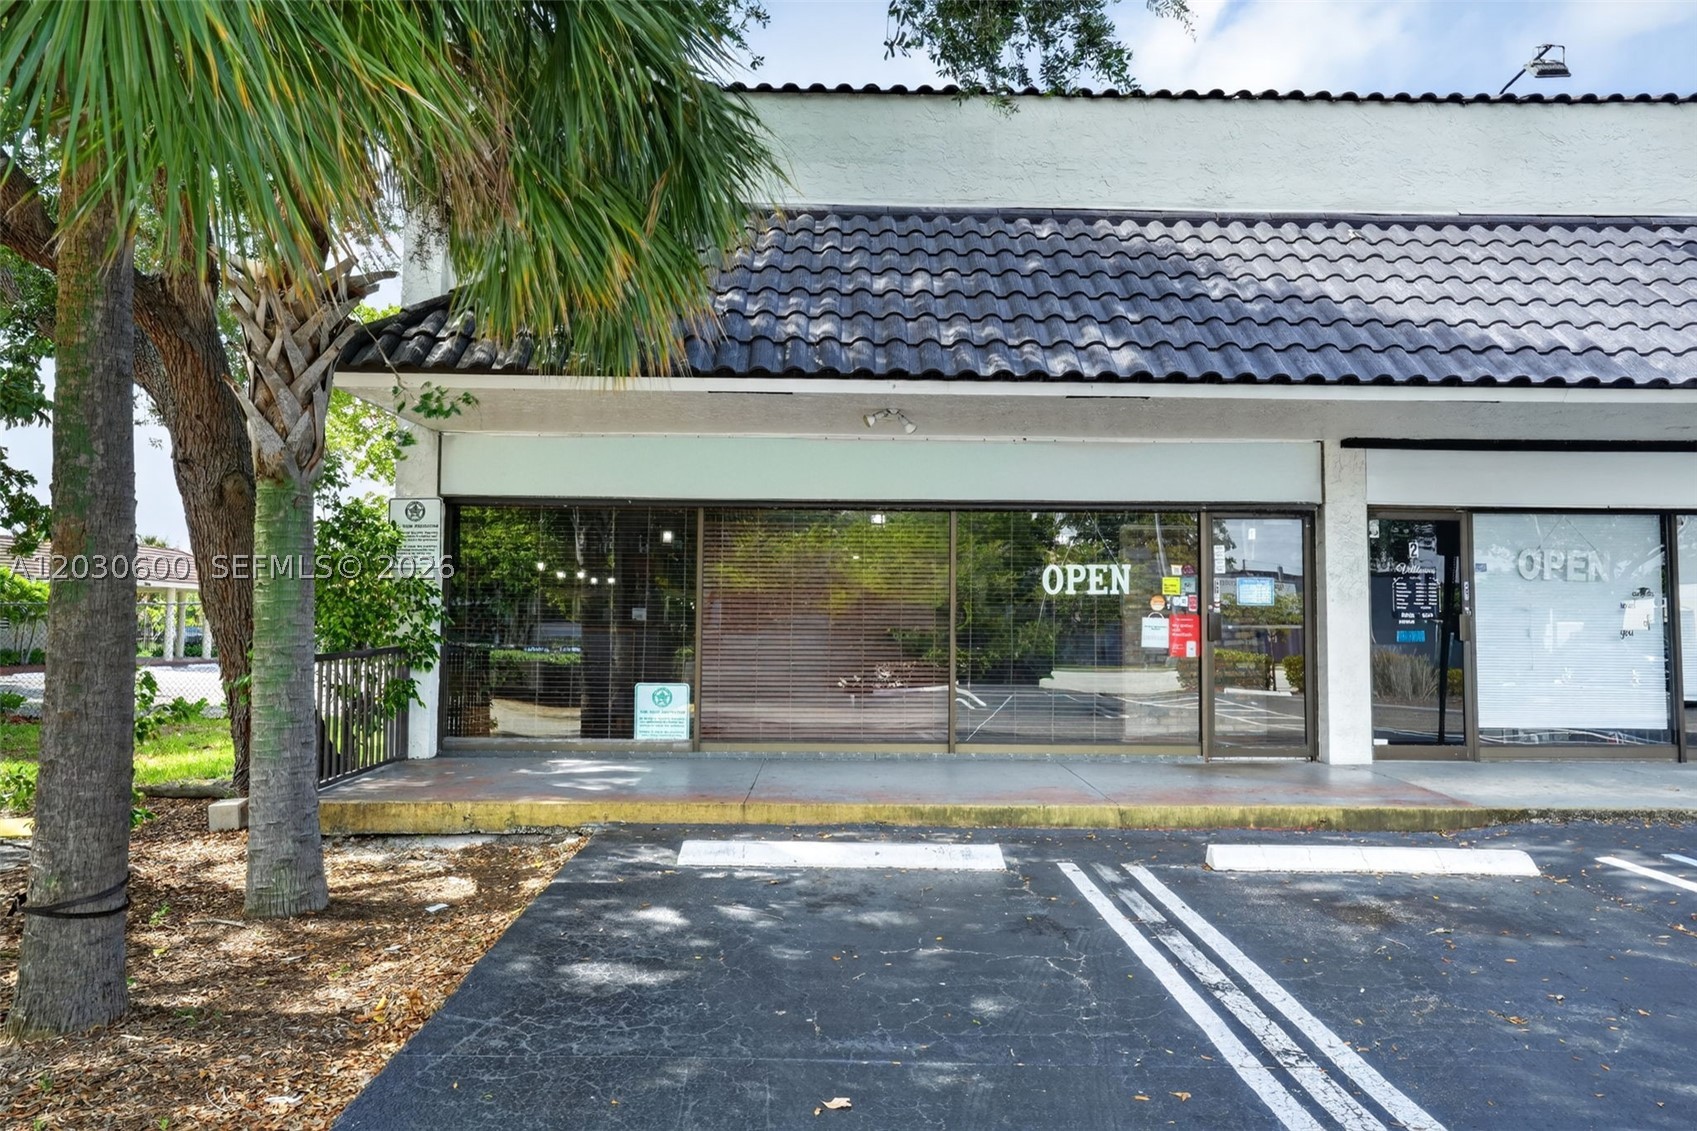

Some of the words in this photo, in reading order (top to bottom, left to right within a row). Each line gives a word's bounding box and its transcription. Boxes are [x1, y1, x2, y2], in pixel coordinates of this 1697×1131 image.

[1410, 543, 1417, 557] 2
[1518, 548, 1610, 582] OPEN
[1042, 564, 1131, 595] OPEN
